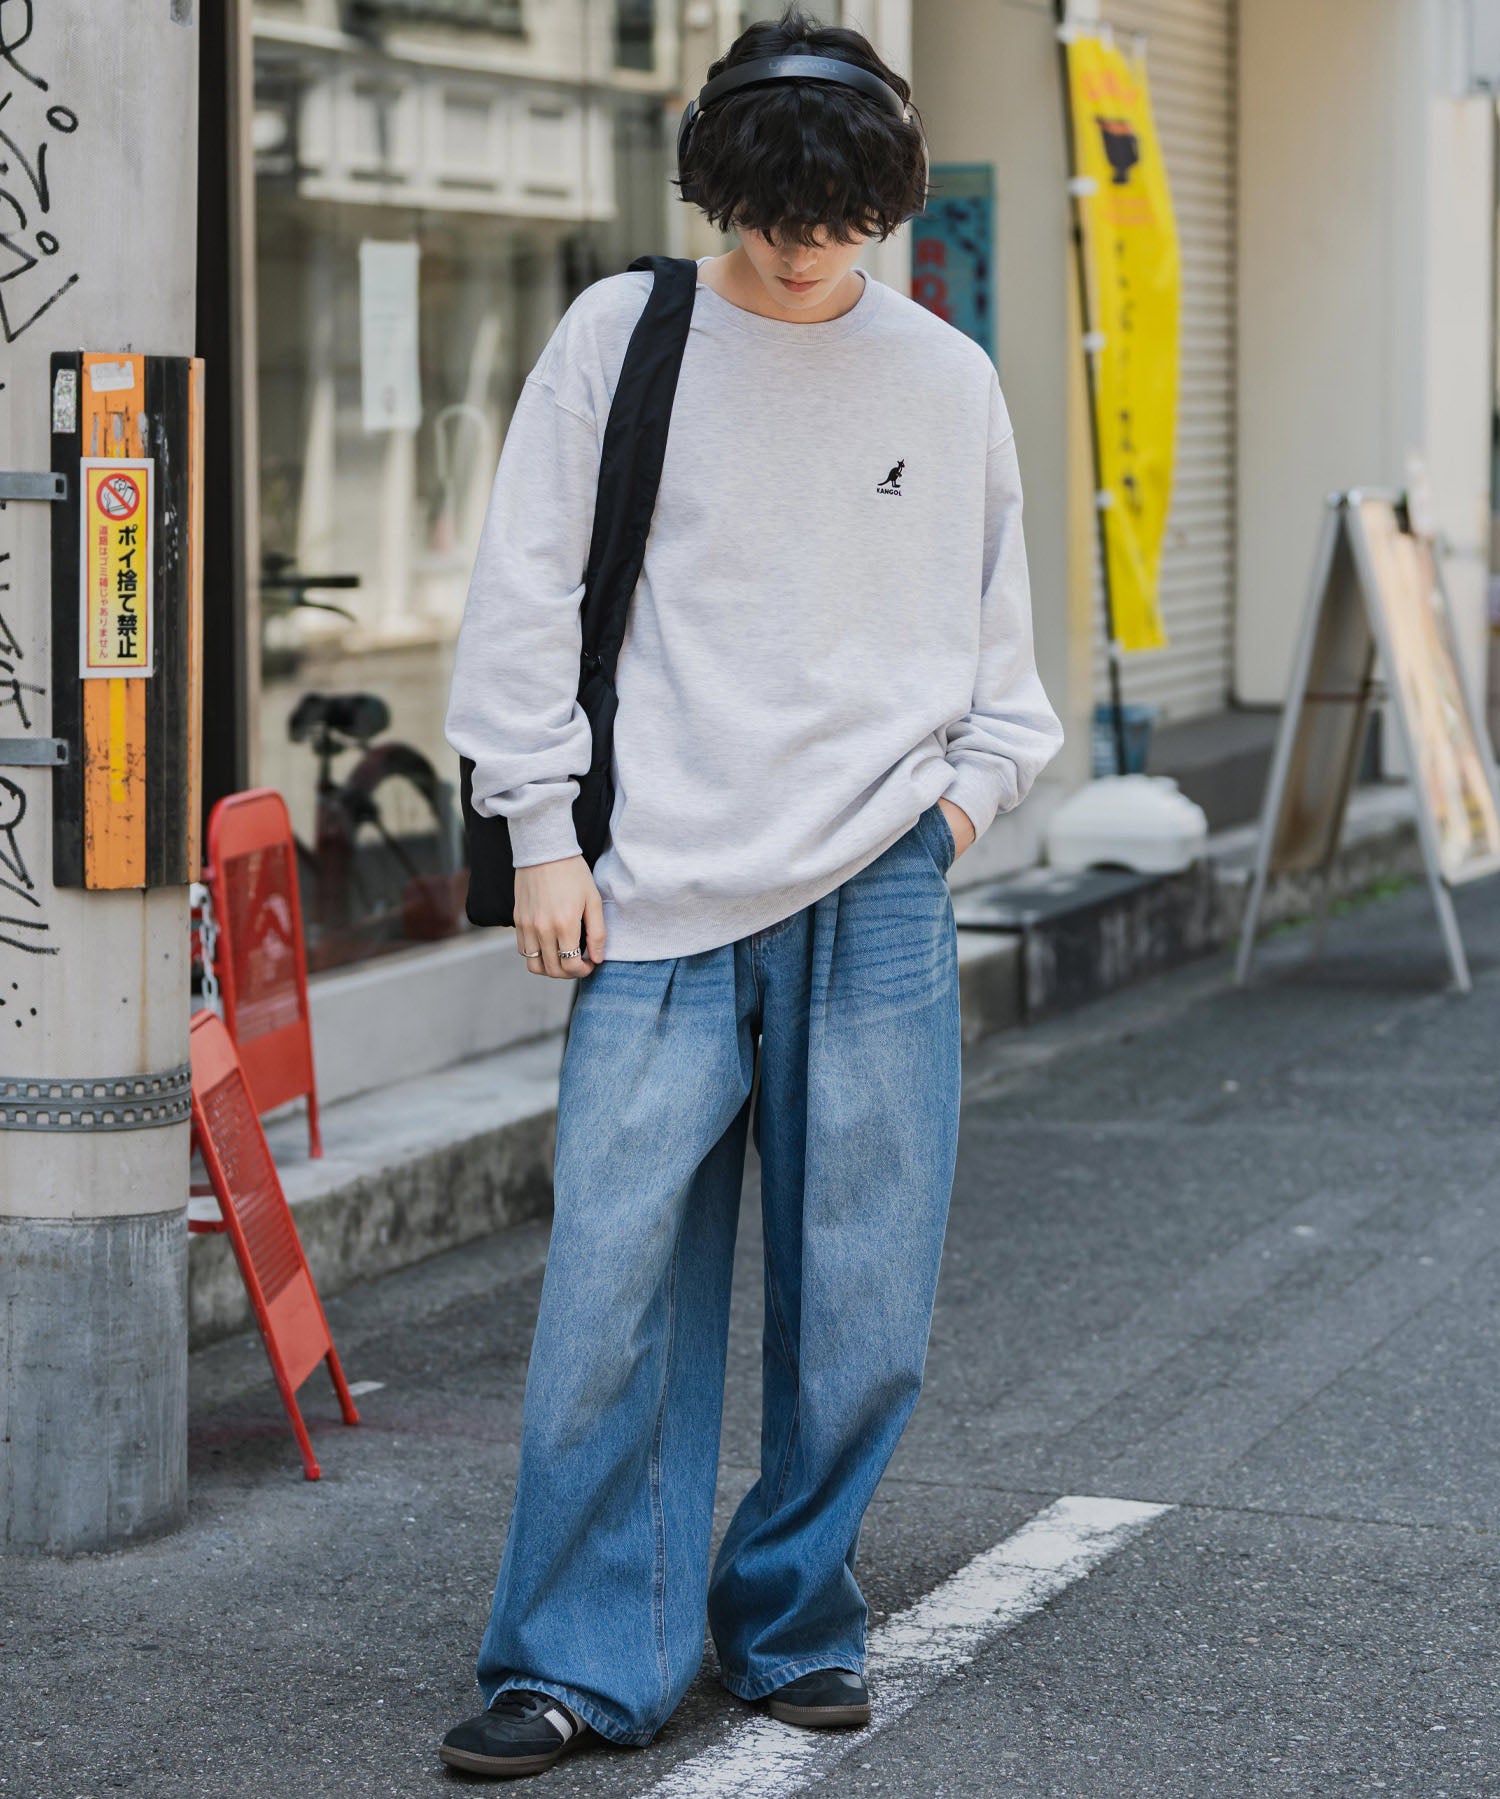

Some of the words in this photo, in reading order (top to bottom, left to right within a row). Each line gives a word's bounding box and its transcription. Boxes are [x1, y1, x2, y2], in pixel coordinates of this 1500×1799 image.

[876, 488, 902, 496] KANGOL
[117, 523, 138, 659] ポイ捨て禁止
